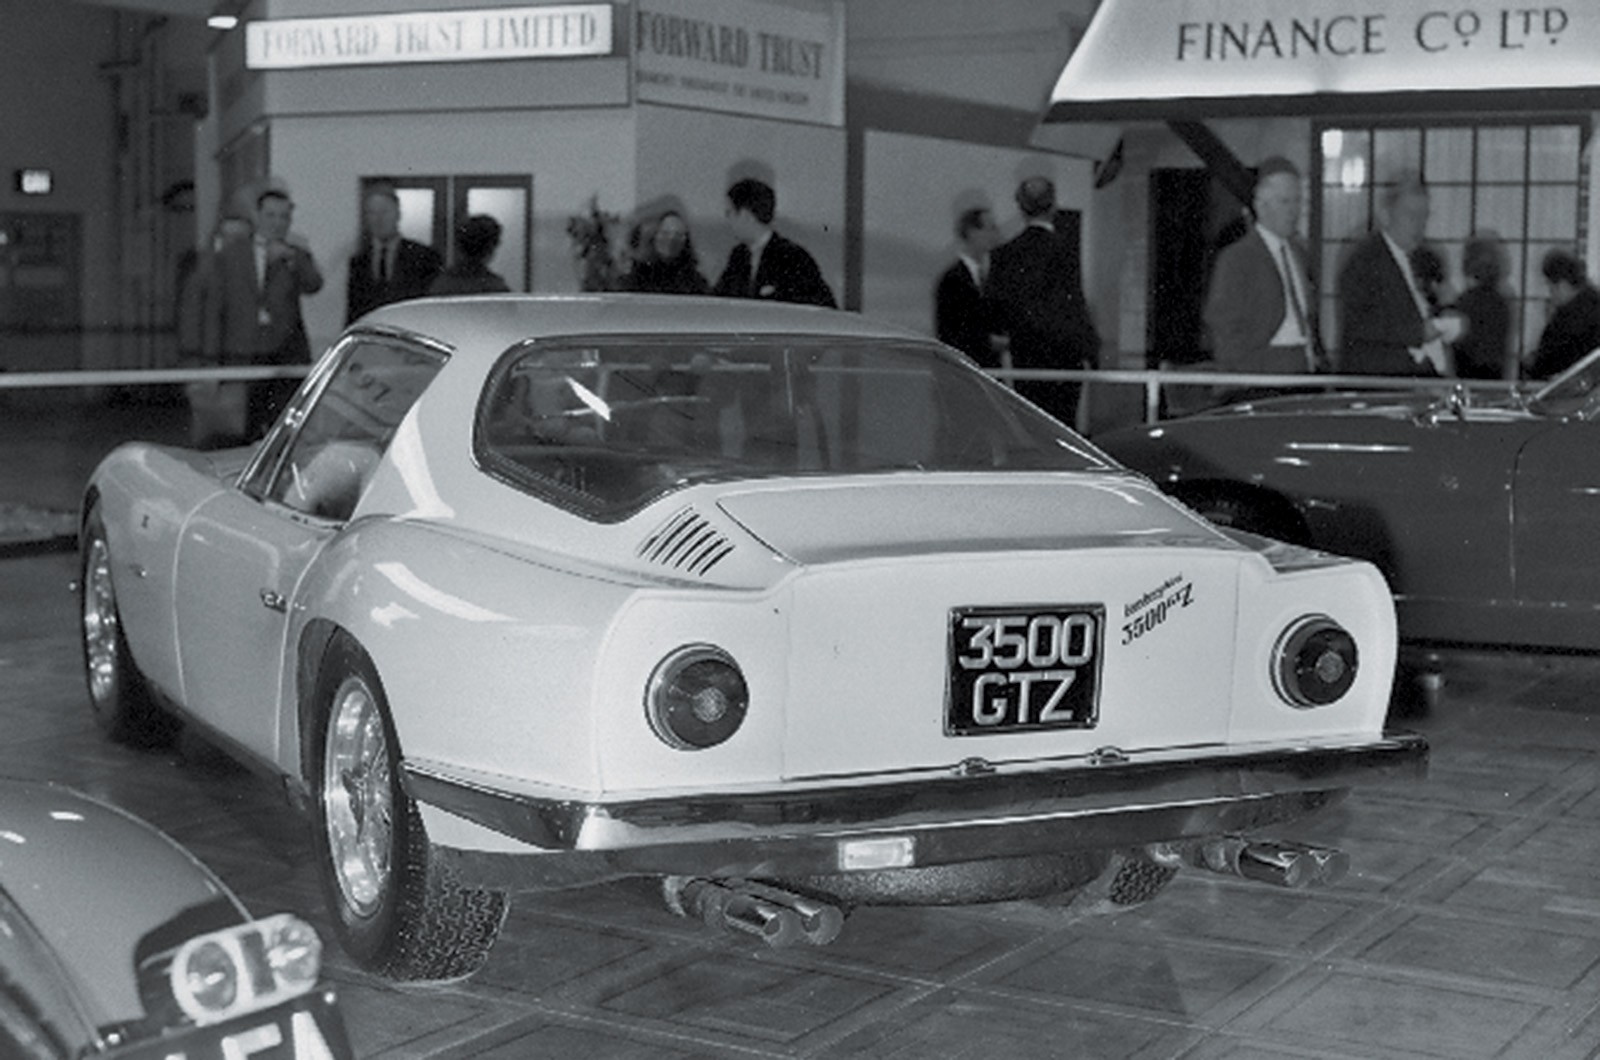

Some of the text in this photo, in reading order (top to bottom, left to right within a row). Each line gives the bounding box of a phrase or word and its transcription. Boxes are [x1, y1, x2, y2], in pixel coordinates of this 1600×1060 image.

[262, 12, 597, 59] FORWARD TRUST LIMITED
[635, 11, 824, 80] FORWARD TRUST
[1176, 15, 1387, 61] FINANCE
[958, 613, 1095, 669] 3500
[972, 669, 1077, 726] GTZ
